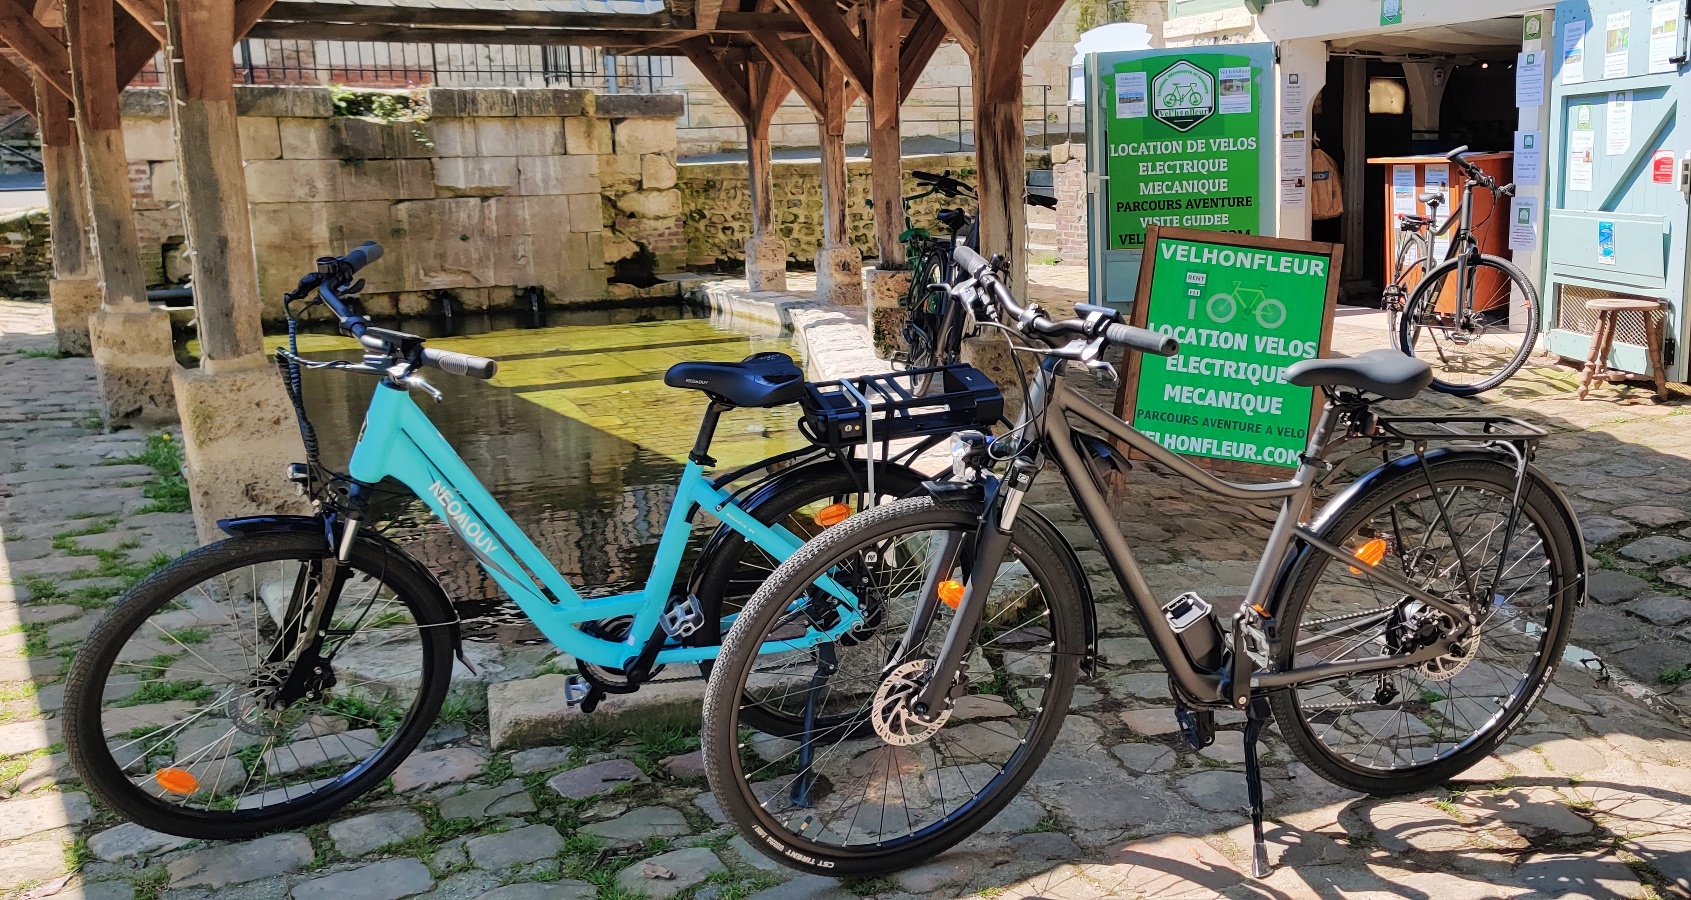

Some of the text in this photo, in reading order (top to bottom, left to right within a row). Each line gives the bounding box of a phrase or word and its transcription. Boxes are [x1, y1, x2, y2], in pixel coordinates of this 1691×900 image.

[1110, 137, 1257, 157] LOCATION DE VELOS
[1138, 158, 1228, 175] ELECTRIQUE
[1138, 178, 1228, 195] MECANIQUE
[1116, 196, 1252, 213] PARCOURS AVENTURE
[1140, 213, 1229, 228] VISITE GUIDEE
[1161, 243, 1325, 277] VELHONFLEUR
[1187, 274, 1205, 282] RENT
[1254, 335, 1317, 359] VELOS
[1165, 352, 1289, 386] ELECTRIQUE
[1163, 384, 1284, 416] MECANIQUE
[1136, 408, 1306, 439] PARCOURS AVENTURE A VELO
[1140, 430, 1301, 466] ELHONFLEUR.COM
[785, 849, 834, 869] CST TIRENT
